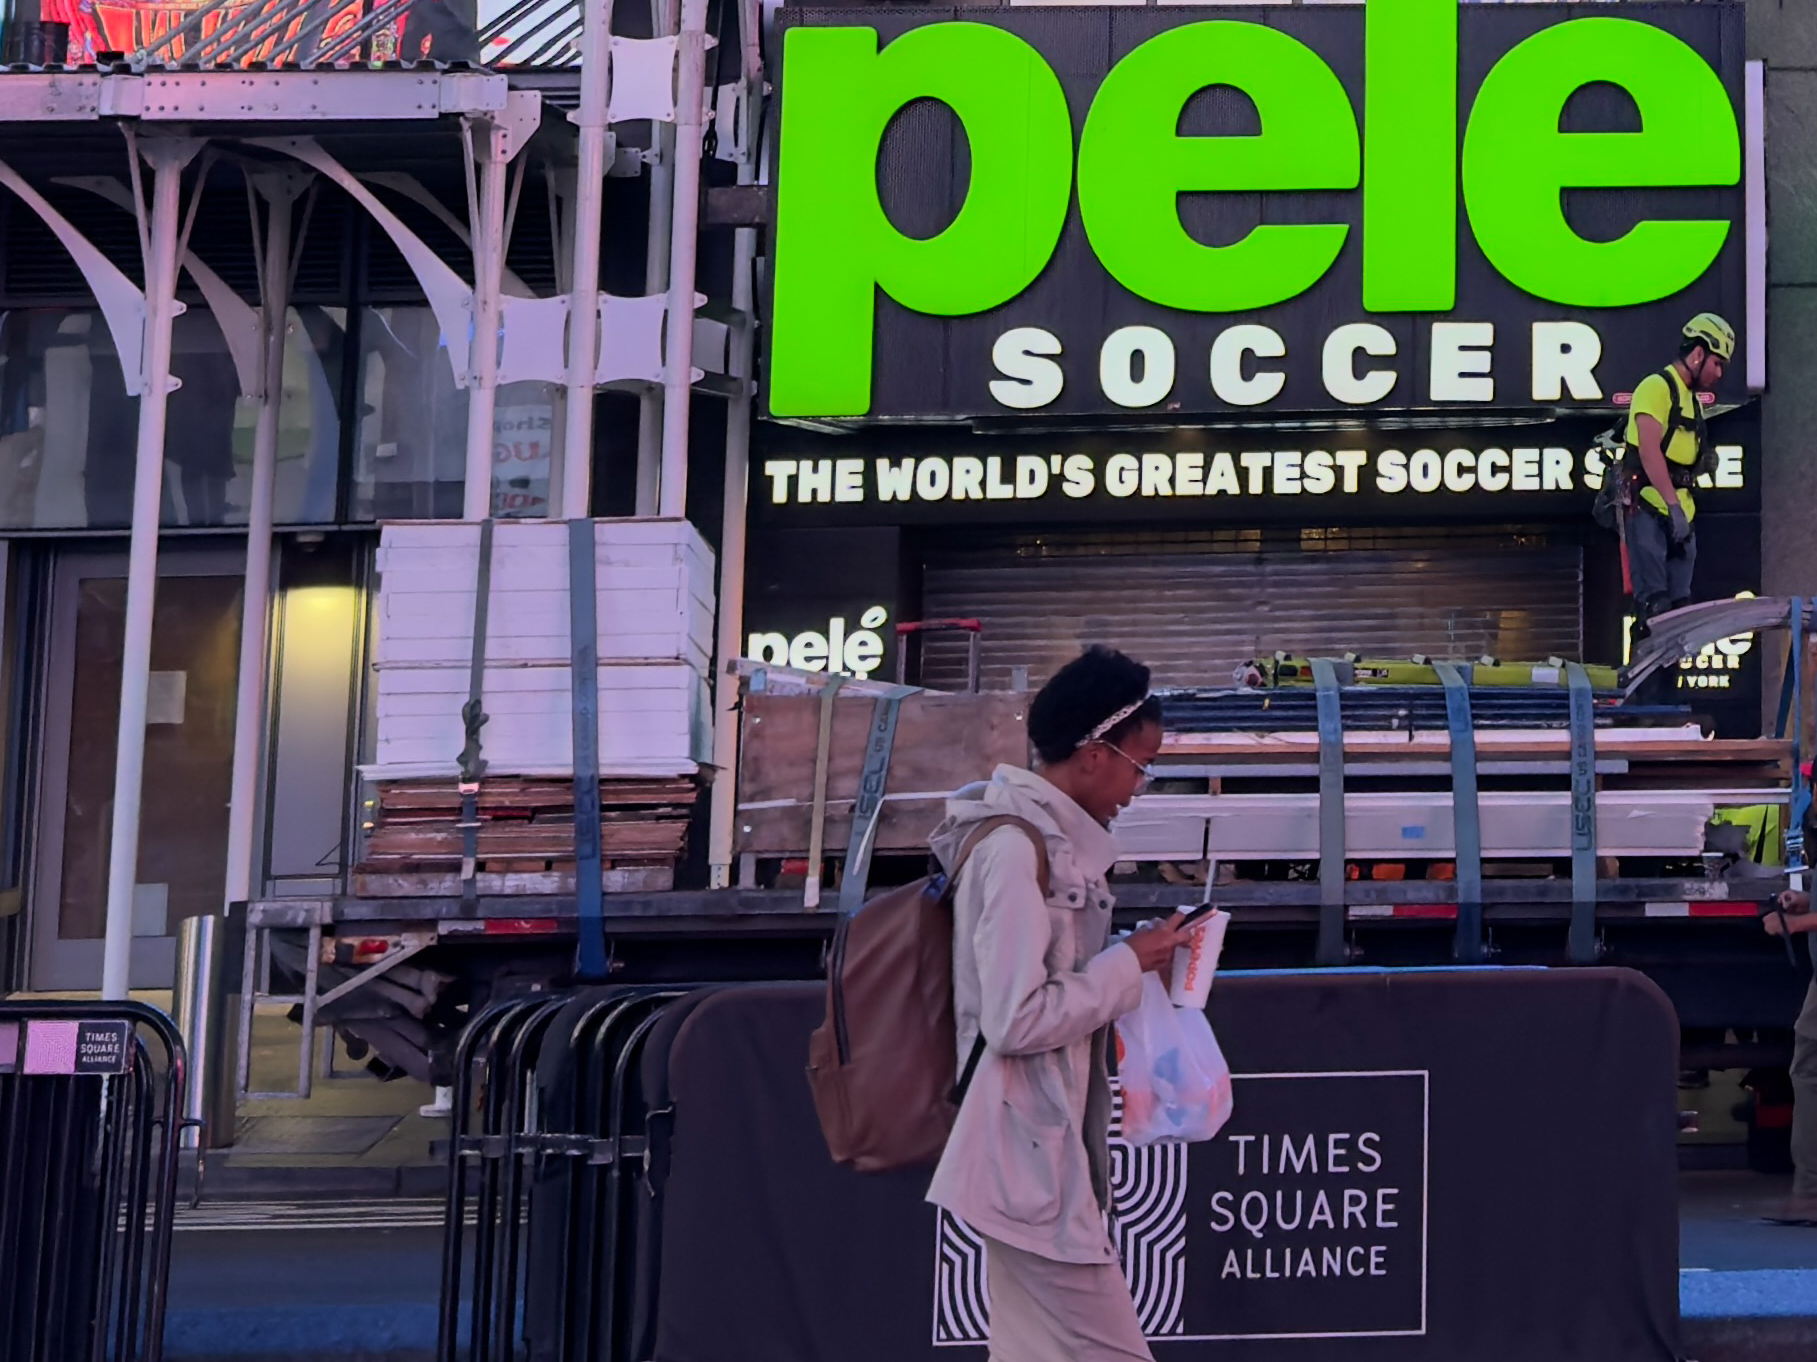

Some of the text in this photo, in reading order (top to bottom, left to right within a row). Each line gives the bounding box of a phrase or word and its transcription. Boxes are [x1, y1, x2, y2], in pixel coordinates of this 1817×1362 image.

[988, 321, 1603, 409] SOCCER
[764, 458, 865, 505] THE
[875, 454, 1096, 503] WORLD'S
[1105, 448, 1367, 498] GREATEST
[1375, 446, 1574, 495] SOCCER
[748, 605, 887, 674] pelé
[1686, 675, 1730, 688] YORK
[80, 1043, 120, 1055] SQUARE
[84, 1032, 119, 1043] TIMES
[81, 1055, 117, 1064] ALLIANCE
[1228, 1132, 1382, 1176] TIMES
[1210, 1188, 1400, 1239] SQUARE
[1220, 1245, 1388, 1280] ALLIANCE
